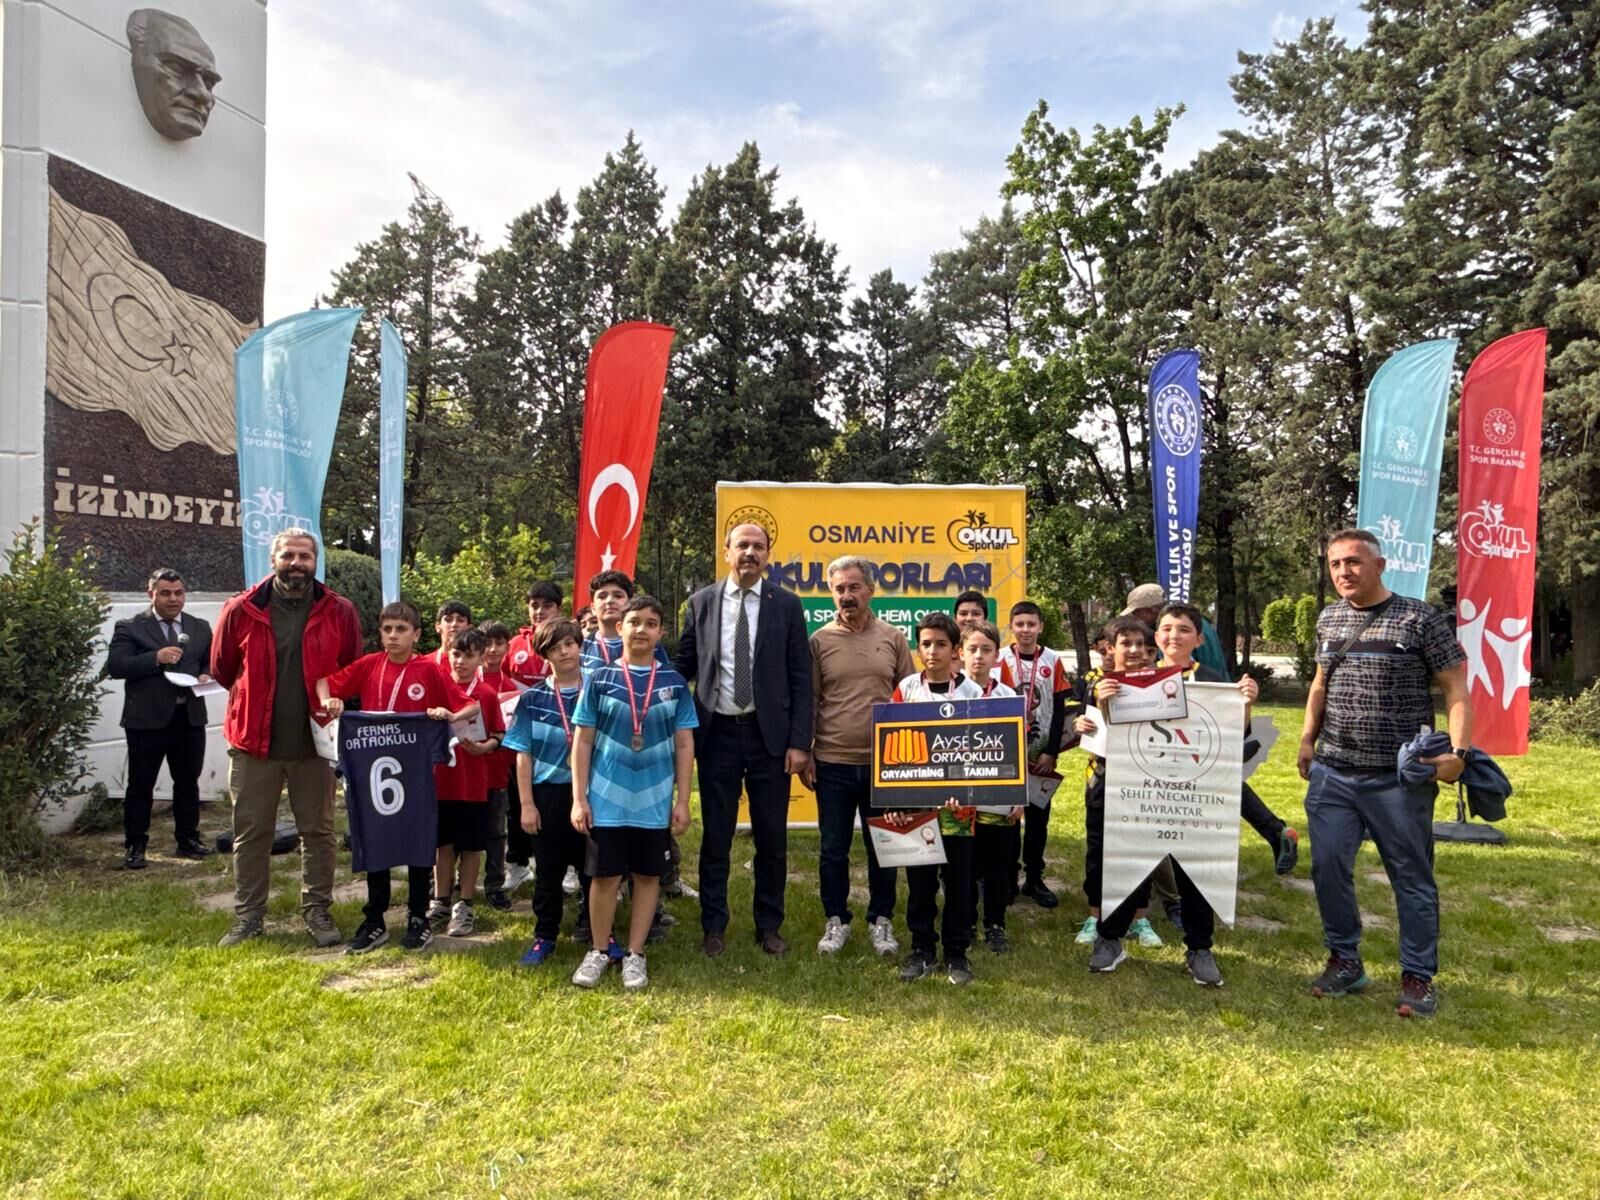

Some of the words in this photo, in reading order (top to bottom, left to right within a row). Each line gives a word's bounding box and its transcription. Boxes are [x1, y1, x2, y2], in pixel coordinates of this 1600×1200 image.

[53, 467, 242, 527] İZİNDEYİ
[1166, 465, 1178, 516] SPOR
[808, 521, 936, 543] OSMANİYE
[957, 526, 1020, 545] OKUL
[1168, 518, 1179, 542] VE
[1468, 522, 1531, 554] OKUL
[868, 562, 992, 594] ORLARI
[1168, 546, 1183, 601] NÇLİK
[877, 609, 912, 622] HEM
[345, 733, 417, 750] ORTAOKULU
[931, 750, 1005, 764] ORTAOKULU
[880, 766, 945, 780] ORYANTİRİNG
[963, 766, 999, 777] TAKIMI
[370, 755, 406, 816] 6
[1143, 778, 1198, 791] KAYSERİ
[1120, 787, 1156, 800] ŞEHİT
[1157, 789, 1226, 805] NECMETTİN
[1140, 803, 1203, 817] BAYRAKTAR
[1121, 814, 1223, 830] ORTAOKULU
[1157, 830, 1185, 840] 2021
